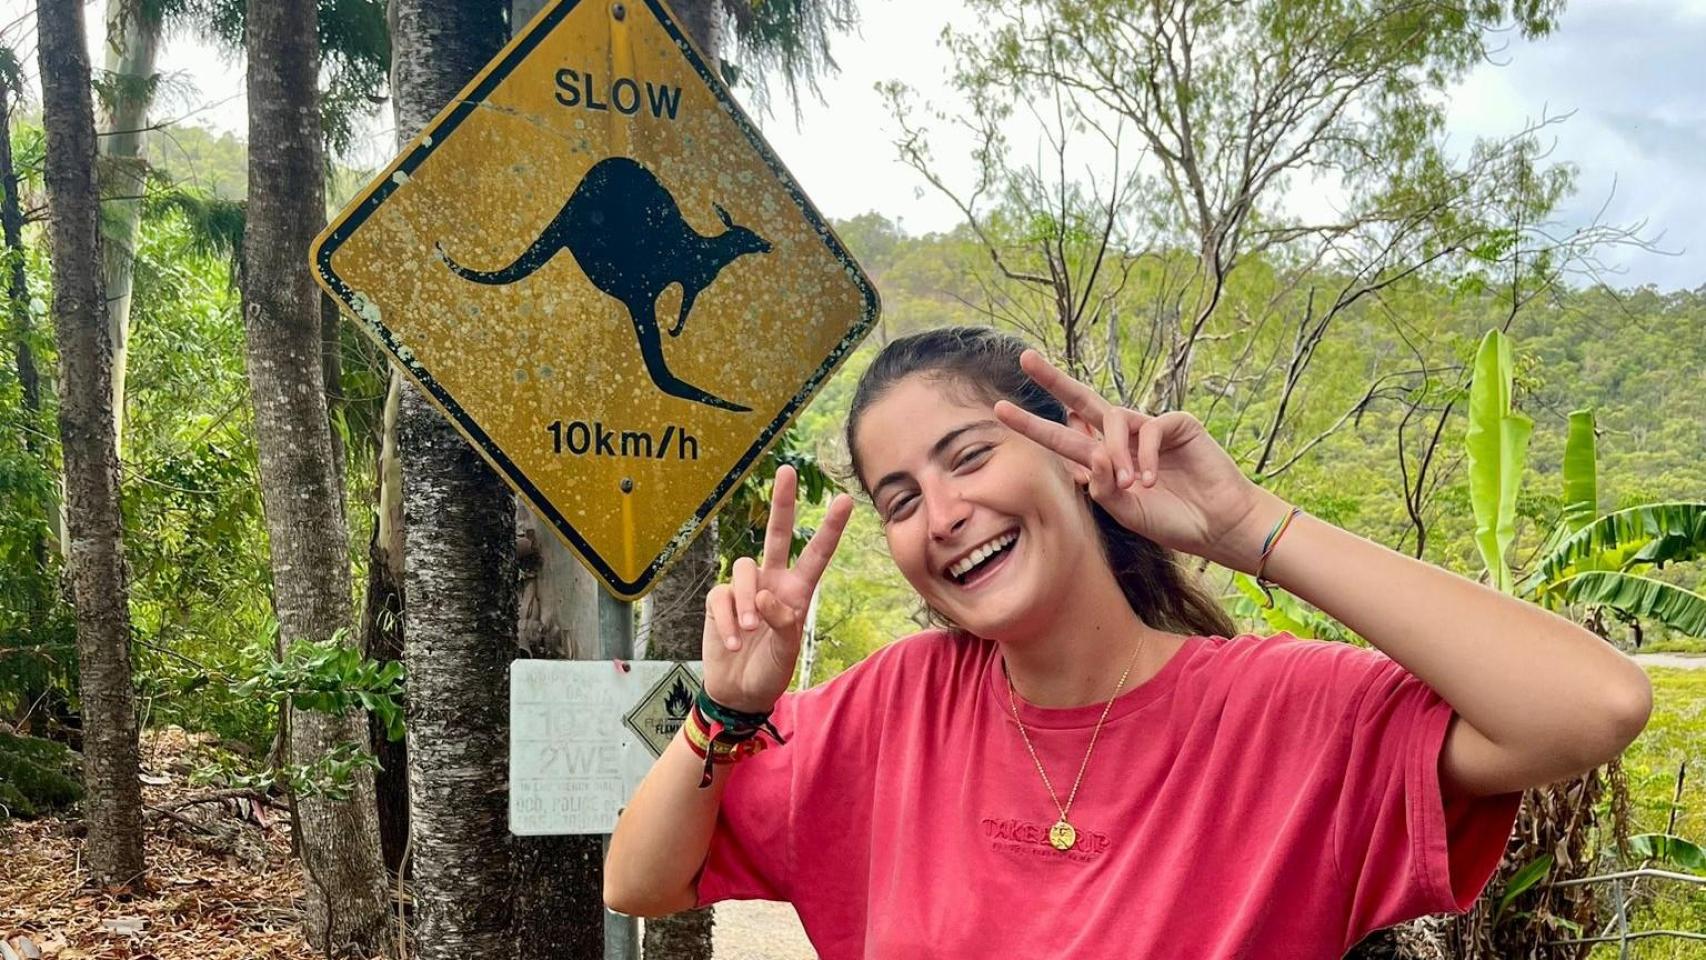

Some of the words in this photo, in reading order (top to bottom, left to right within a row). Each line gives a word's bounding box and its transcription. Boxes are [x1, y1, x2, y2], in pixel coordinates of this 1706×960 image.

[555, 68, 682, 120] SLOW
[547, 420, 698, 460] 10km/h
[1072, 829, 1112, 854] RIP
